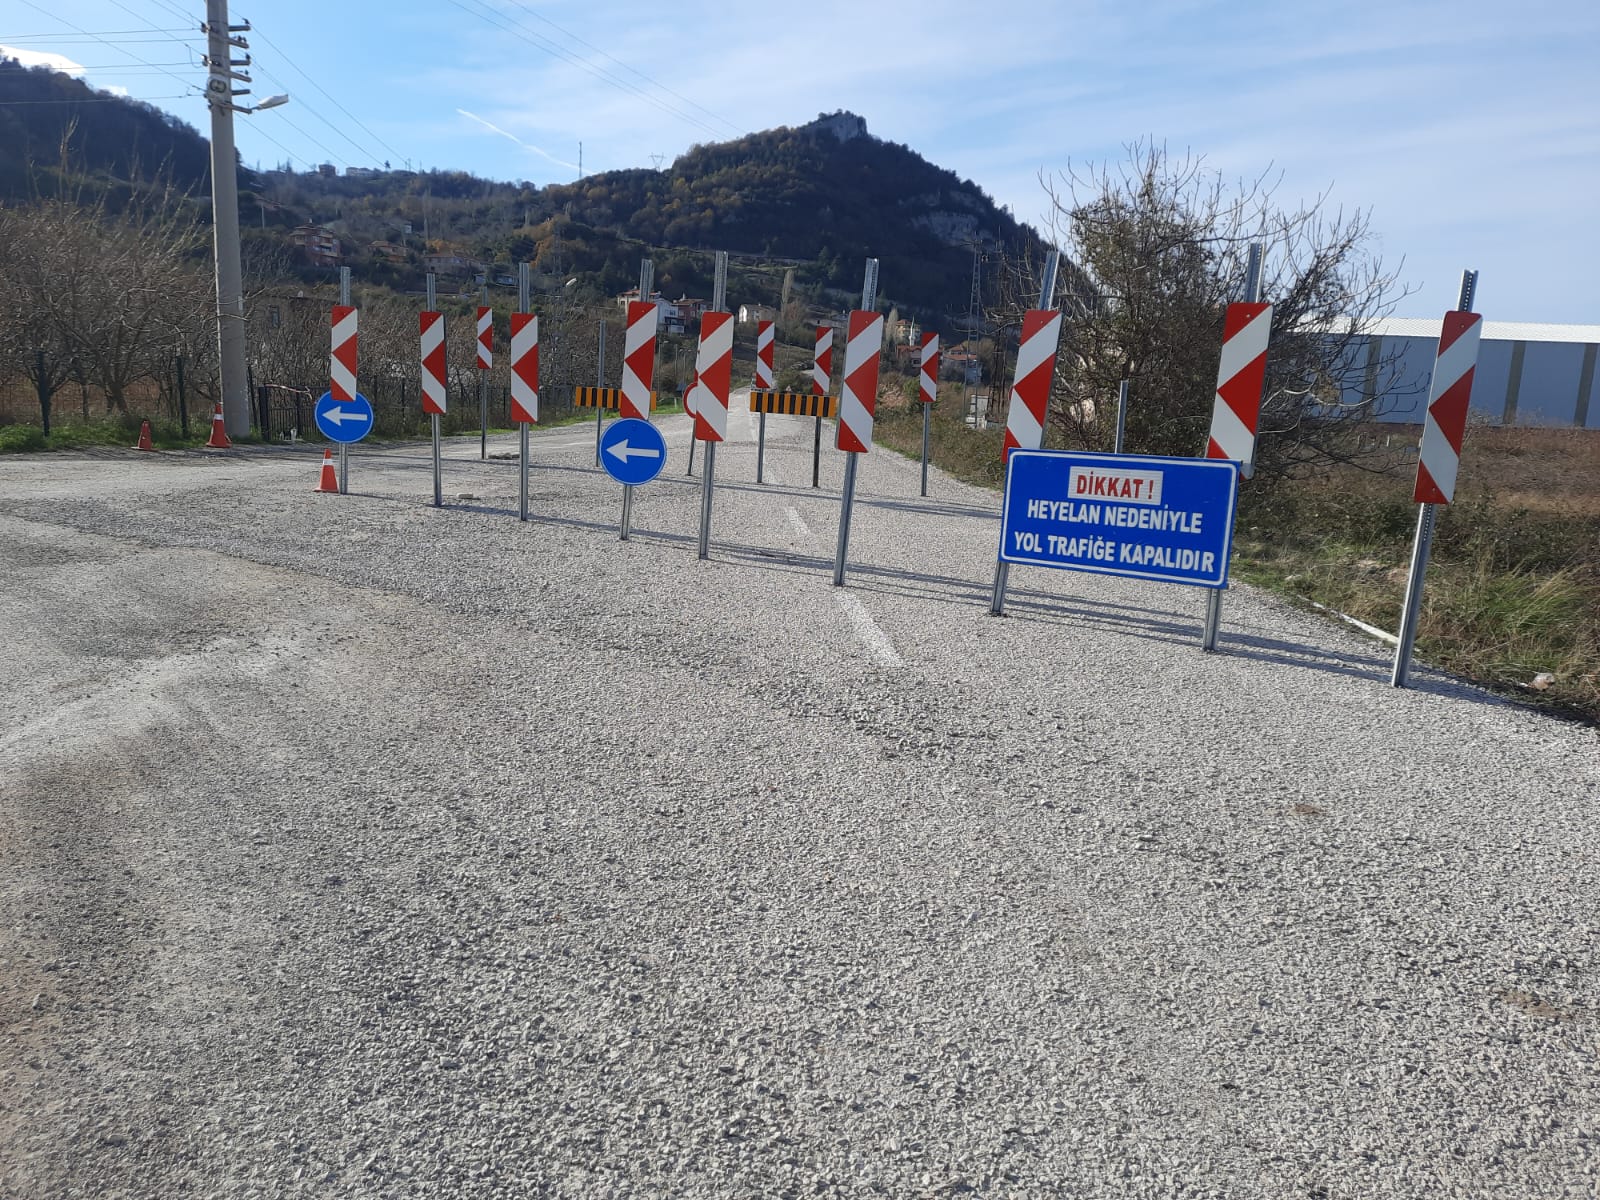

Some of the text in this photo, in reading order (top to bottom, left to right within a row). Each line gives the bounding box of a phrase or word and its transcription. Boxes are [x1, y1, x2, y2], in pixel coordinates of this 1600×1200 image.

[1076, 471, 1144, 498] DİKKAT
[1027, 499, 1203, 533] HEYELAN NEDENİYLE
[1014, 531, 1214, 573] YOL TRAFİĞE KAPALIDIR
